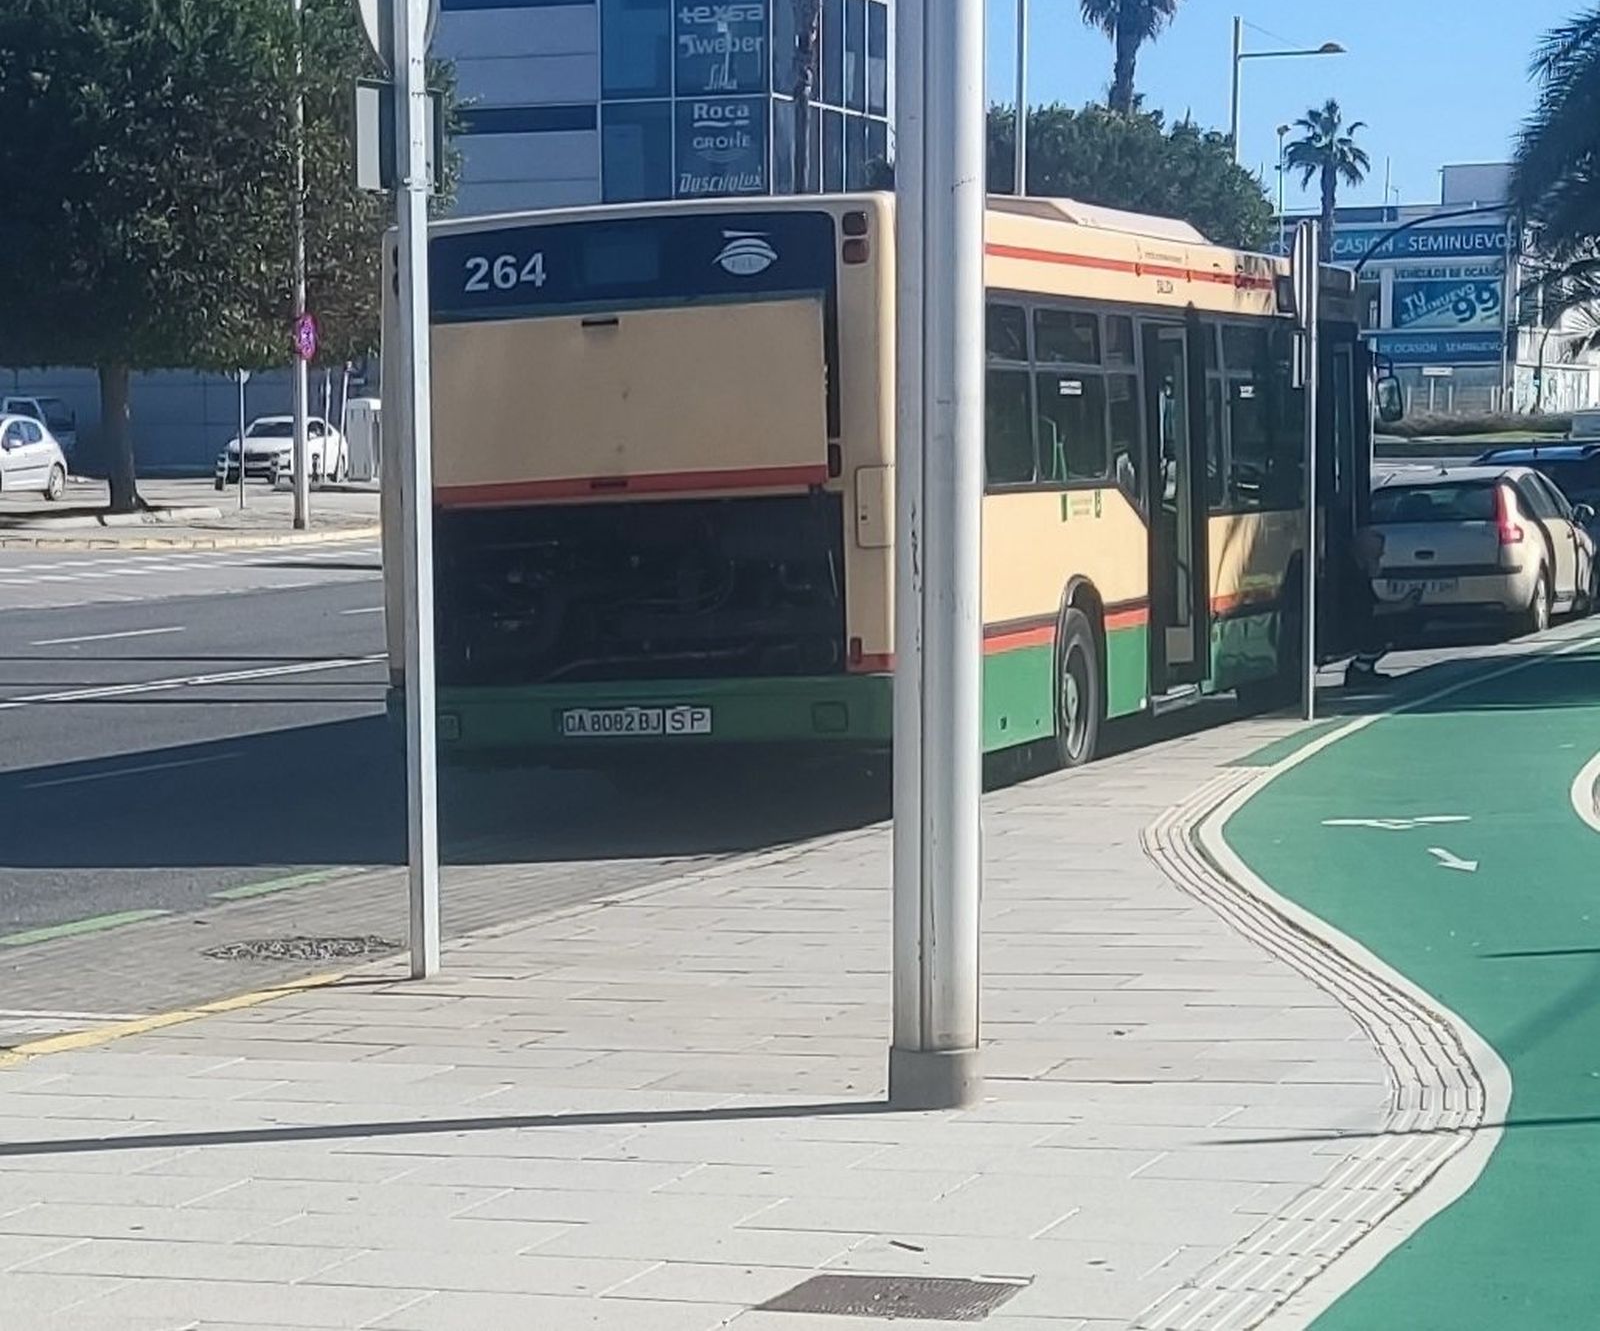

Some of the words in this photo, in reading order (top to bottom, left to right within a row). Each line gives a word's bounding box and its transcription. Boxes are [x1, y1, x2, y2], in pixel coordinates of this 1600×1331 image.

[694, 103, 749, 119] Roca
[465, 252, 546, 291] 264
[591, 714, 635, 732] 8082
[639, 712, 661, 731] BJ
[670, 710, 706, 732] SP
